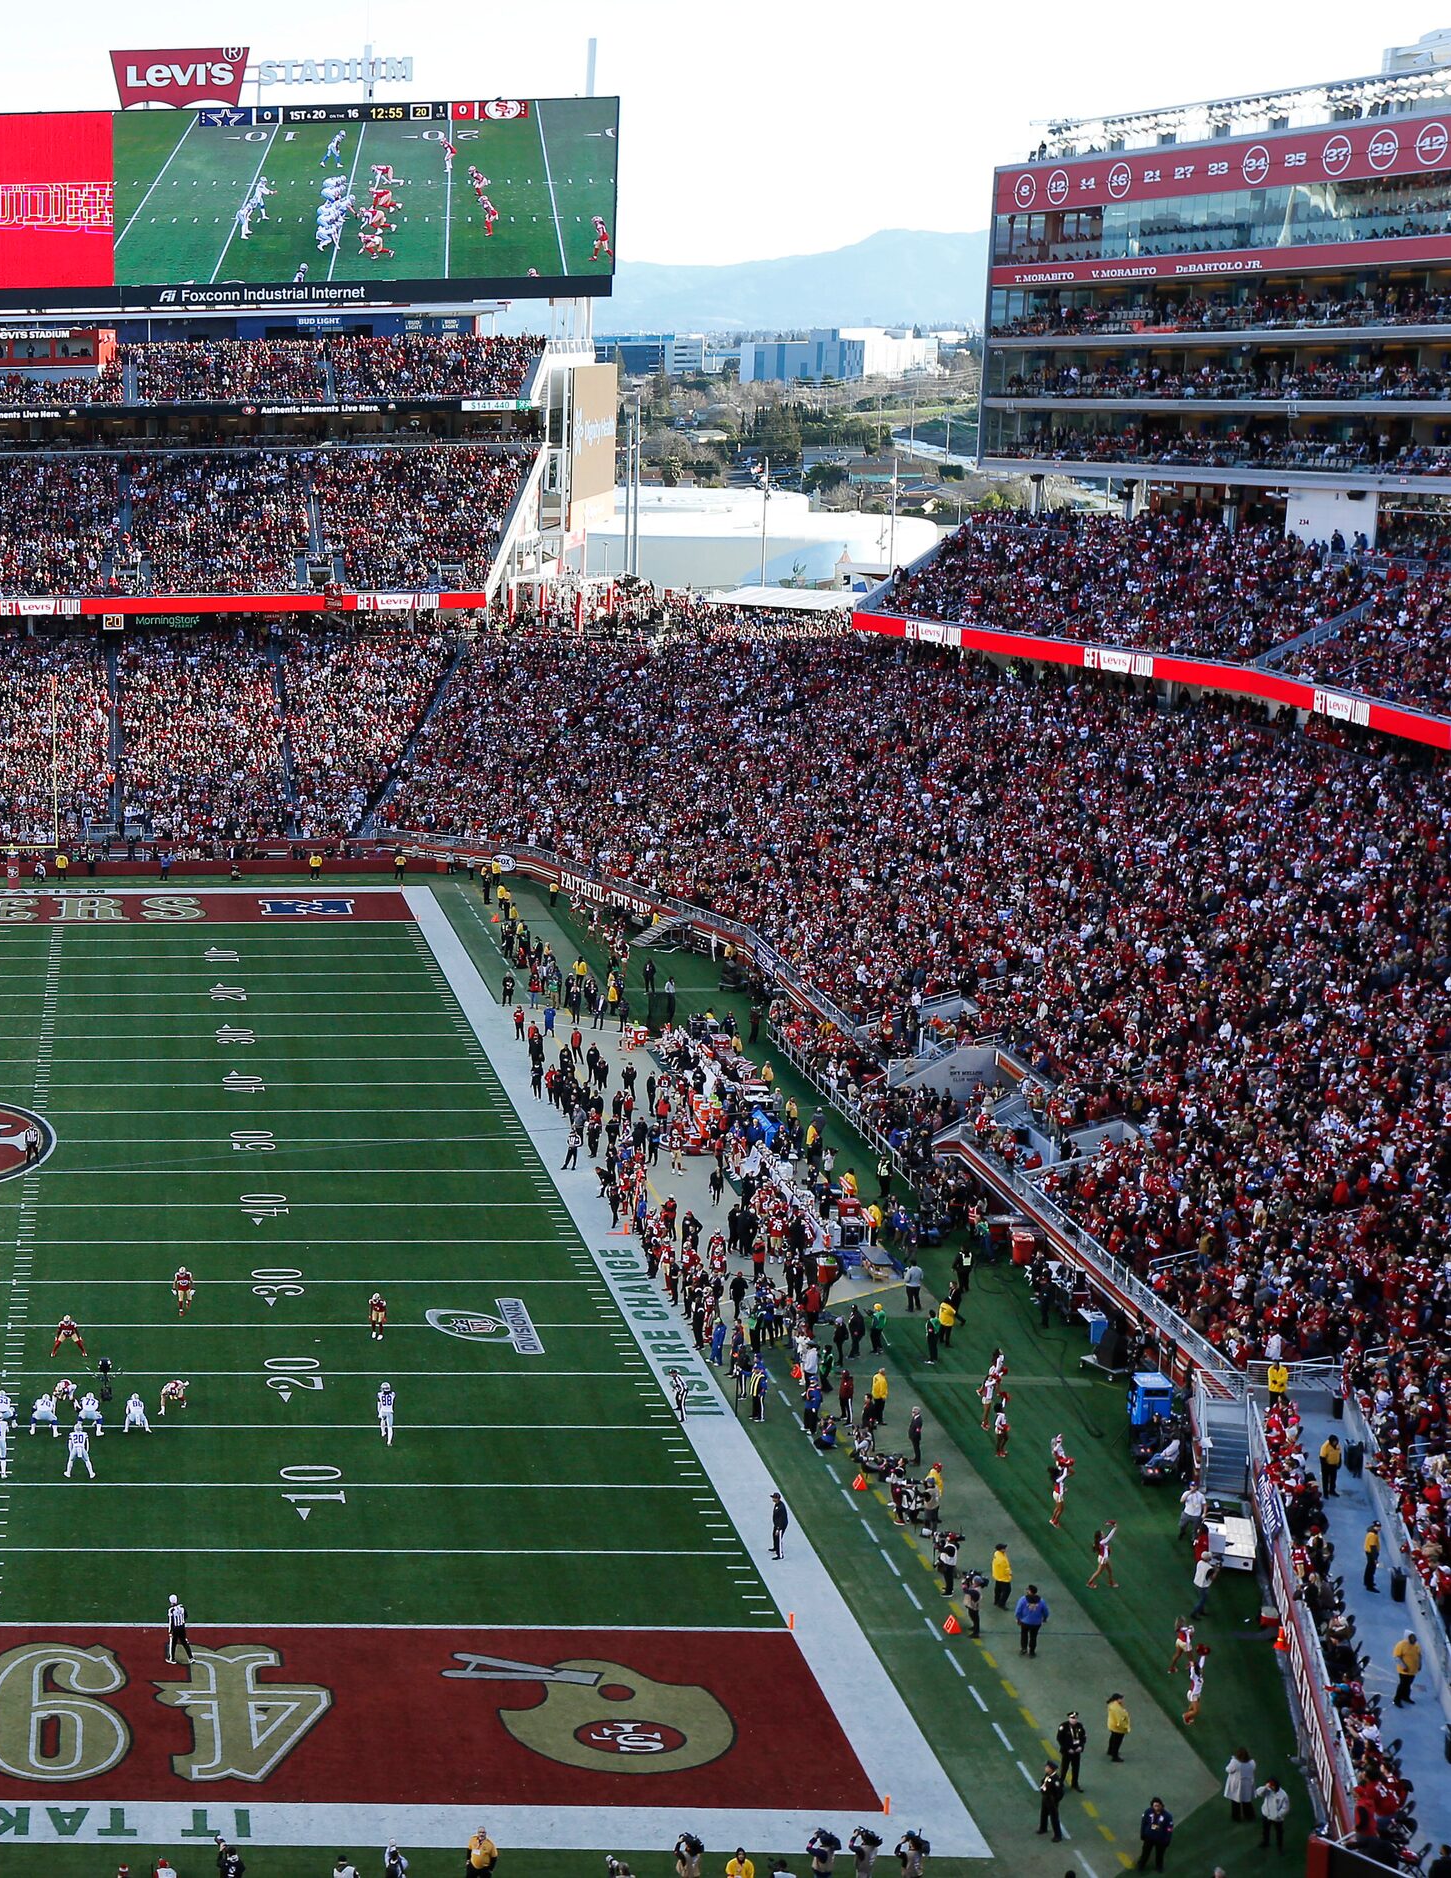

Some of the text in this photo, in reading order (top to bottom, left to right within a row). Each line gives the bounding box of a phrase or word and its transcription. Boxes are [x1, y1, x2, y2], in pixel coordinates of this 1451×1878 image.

[258, 56, 413, 85] STADIUM
[263, 110, 272, 121] 0
[289, 110, 306, 121] 1ST
[312, 110, 326, 120] 20
[347, 109, 359, 119] 16
[369, 107, 403, 119] 12:55
[415, 107, 427, 116] 20
[458, 105, 467, 115] 0
[1370, 142, 1396, 157] 39
[1419, 135, 1447, 150] 42
[1284, 152, 1307, 167] 35
[1325, 148, 1350, 162] 37
[1208, 162, 1229, 176] 33
[1245, 158, 1267, 171] 34
[1110, 174, 1127, 187] 16
[1143, 170, 1161, 183] 21
[1174, 166, 1195, 180] 27
[1019, 185, 1030, 196] 8
[1050, 180, 1065, 193] 12
[1079, 177, 1096, 190] 14
[1245, 260, 1263, 269] JR.
[1023, 272, 1075, 282] MORABITO
[1100, 267, 1157, 278] MORABITO
[181, 288, 240, 302] Foxconn
[243, 287, 309, 300] Industrial
[311, 285, 365, 300] Internet
[299, 317, 340, 326] BUD LIGHT
[29, 330, 70, 339] STADIUM
[22, 410, 39, 418] Live
[40, 410, 61, 418] Here.
[261, 404, 381, 414] Authentic Moments Live Here.
[0, 600, 17, 616] GET
[57, 599, 81, 614] LOUD
[357, 595, 375, 610] GET
[414, 594, 440, 609] LOUD
[106, 616, 121, 627] 20
[135, 615, 197, 628] MorningStar
[905, 621, 918, 639] GET
[943, 627, 961, 646] LOUD
[1083, 647, 1098, 668] GET
[1133, 655, 1154, 678] LOUD
[1313, 689, 1326, 714] GET
[1351, 699, 1370, 727] LOUD
[560, 871, 605, 902] FAITHFUL
[204, 949, 239, 963] 10
[209, 986, 247, 1001] 20
[215, 1028, 256, 1045] 30
[222, 1074, 265, 1093] 40
[229, 1130, 276, 1151] 50
[239, 1194, 289, 1217] 40
[772, 1221, 783, 1231] 76
[251, 1268, 305, 1296] 30
[599, 1249, 670, 1321] CHANGE
[503, 1301, 538, 1351] DIVISIONAL
[264, 1357, 324, 1390] 20
[73, 1434, 84, 1444] 20
[279, 1465, 346, 1505] 10
[181, 1809, 251, 1838] IT
